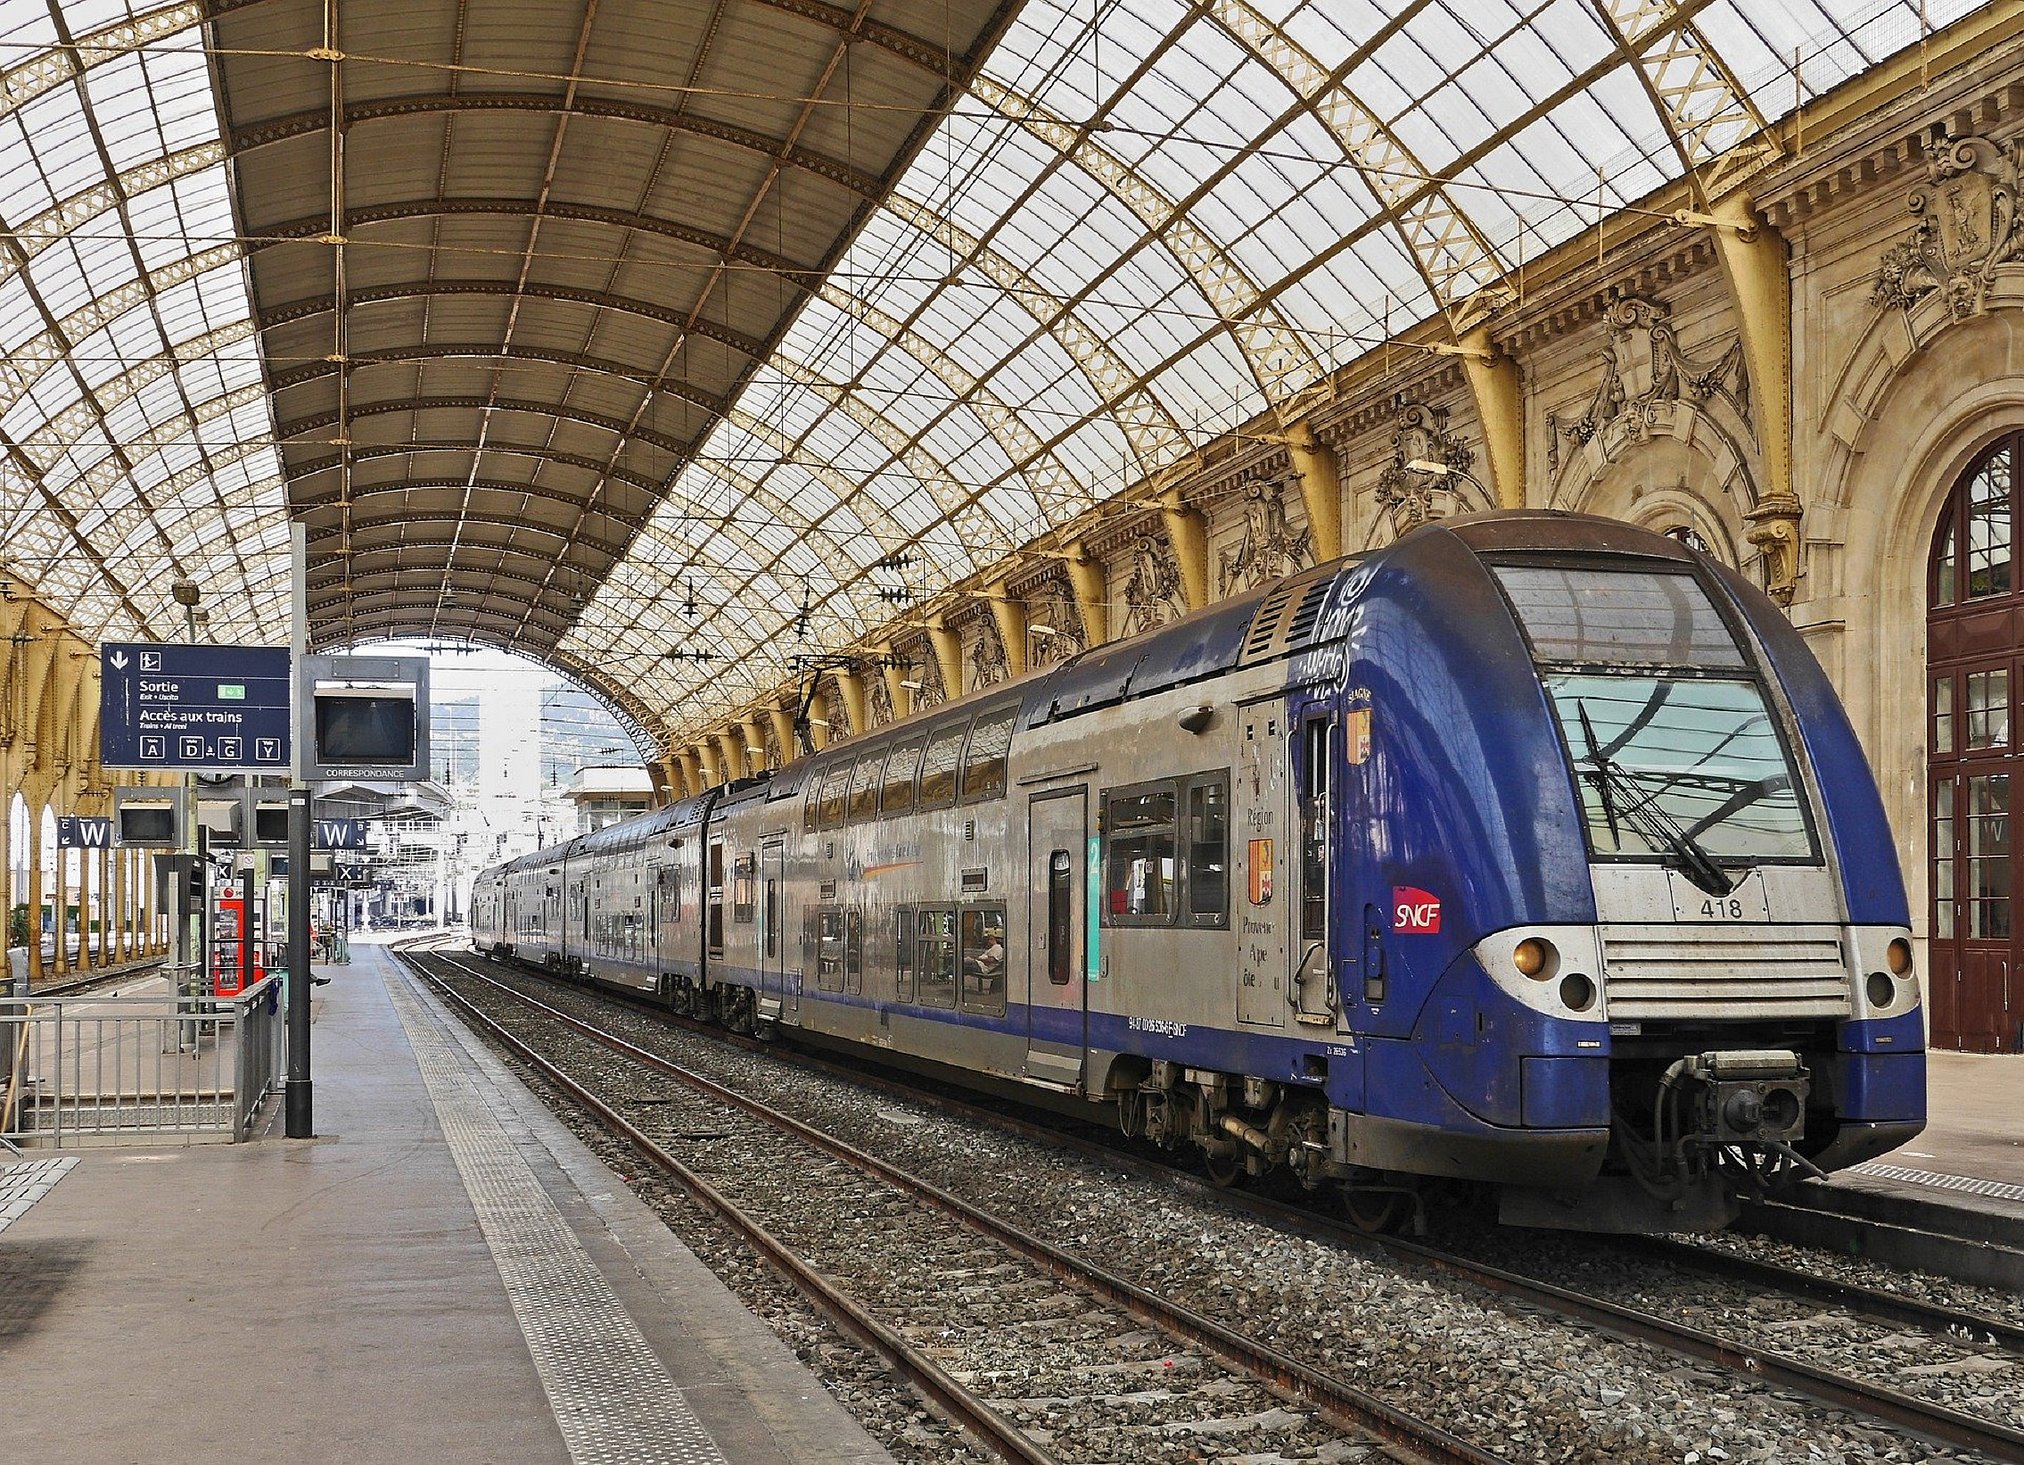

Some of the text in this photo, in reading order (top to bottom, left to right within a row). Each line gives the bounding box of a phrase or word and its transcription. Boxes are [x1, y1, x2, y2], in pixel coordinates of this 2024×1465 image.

[139, 680, 179, 692] Sortie
[139, 709, 243, 724] Accès aux trains
[147, 745, 158, 756] A
[186, 745, 198, 756] D
[224, 745, 235, 757] G
[263, 746, 273, 758] Y
[326, 769, 405, 778] CORRESPONDANCE
[1247, 806, 1274, 833] Région
[80, 822, 106, 846] W
[323, 824, 348, 847] W
[1090, 842, 1098, 874] 2
[340, 867, 352, 880] X
[1394, 903, 1441, 928] SNCF
[1700, 899, 1742, 919] 418
